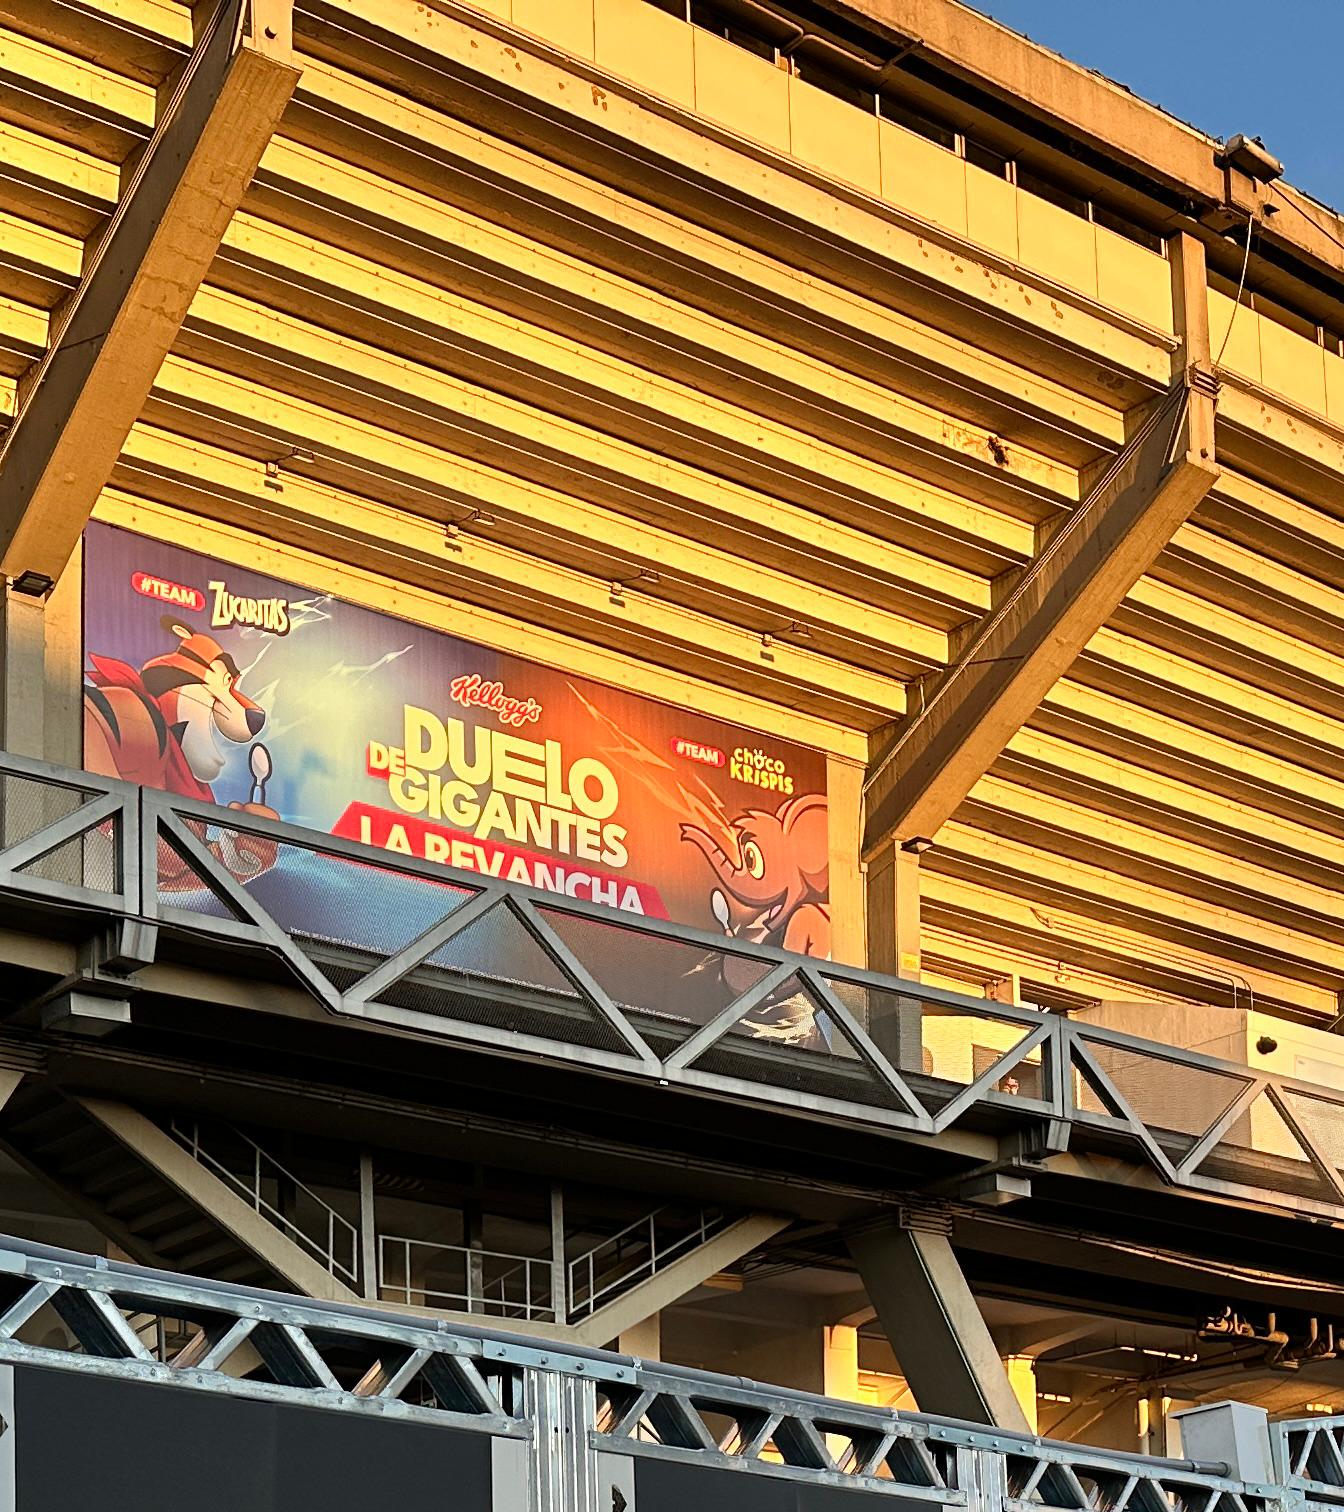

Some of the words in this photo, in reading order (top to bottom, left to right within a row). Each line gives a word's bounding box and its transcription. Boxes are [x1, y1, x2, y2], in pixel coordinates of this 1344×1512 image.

[140, 577, 196, 607] #TEAM
[208, 579, 290, 634] ZUCARITAS
[451, 674, 542, 726] Kellogg's
[404, 704, 619, 820] DUELO
[675, 740, 719, 764] #TEAM
[368, 740, 406, 777] DE
[388, 764, 630, 868] GIGANTES
